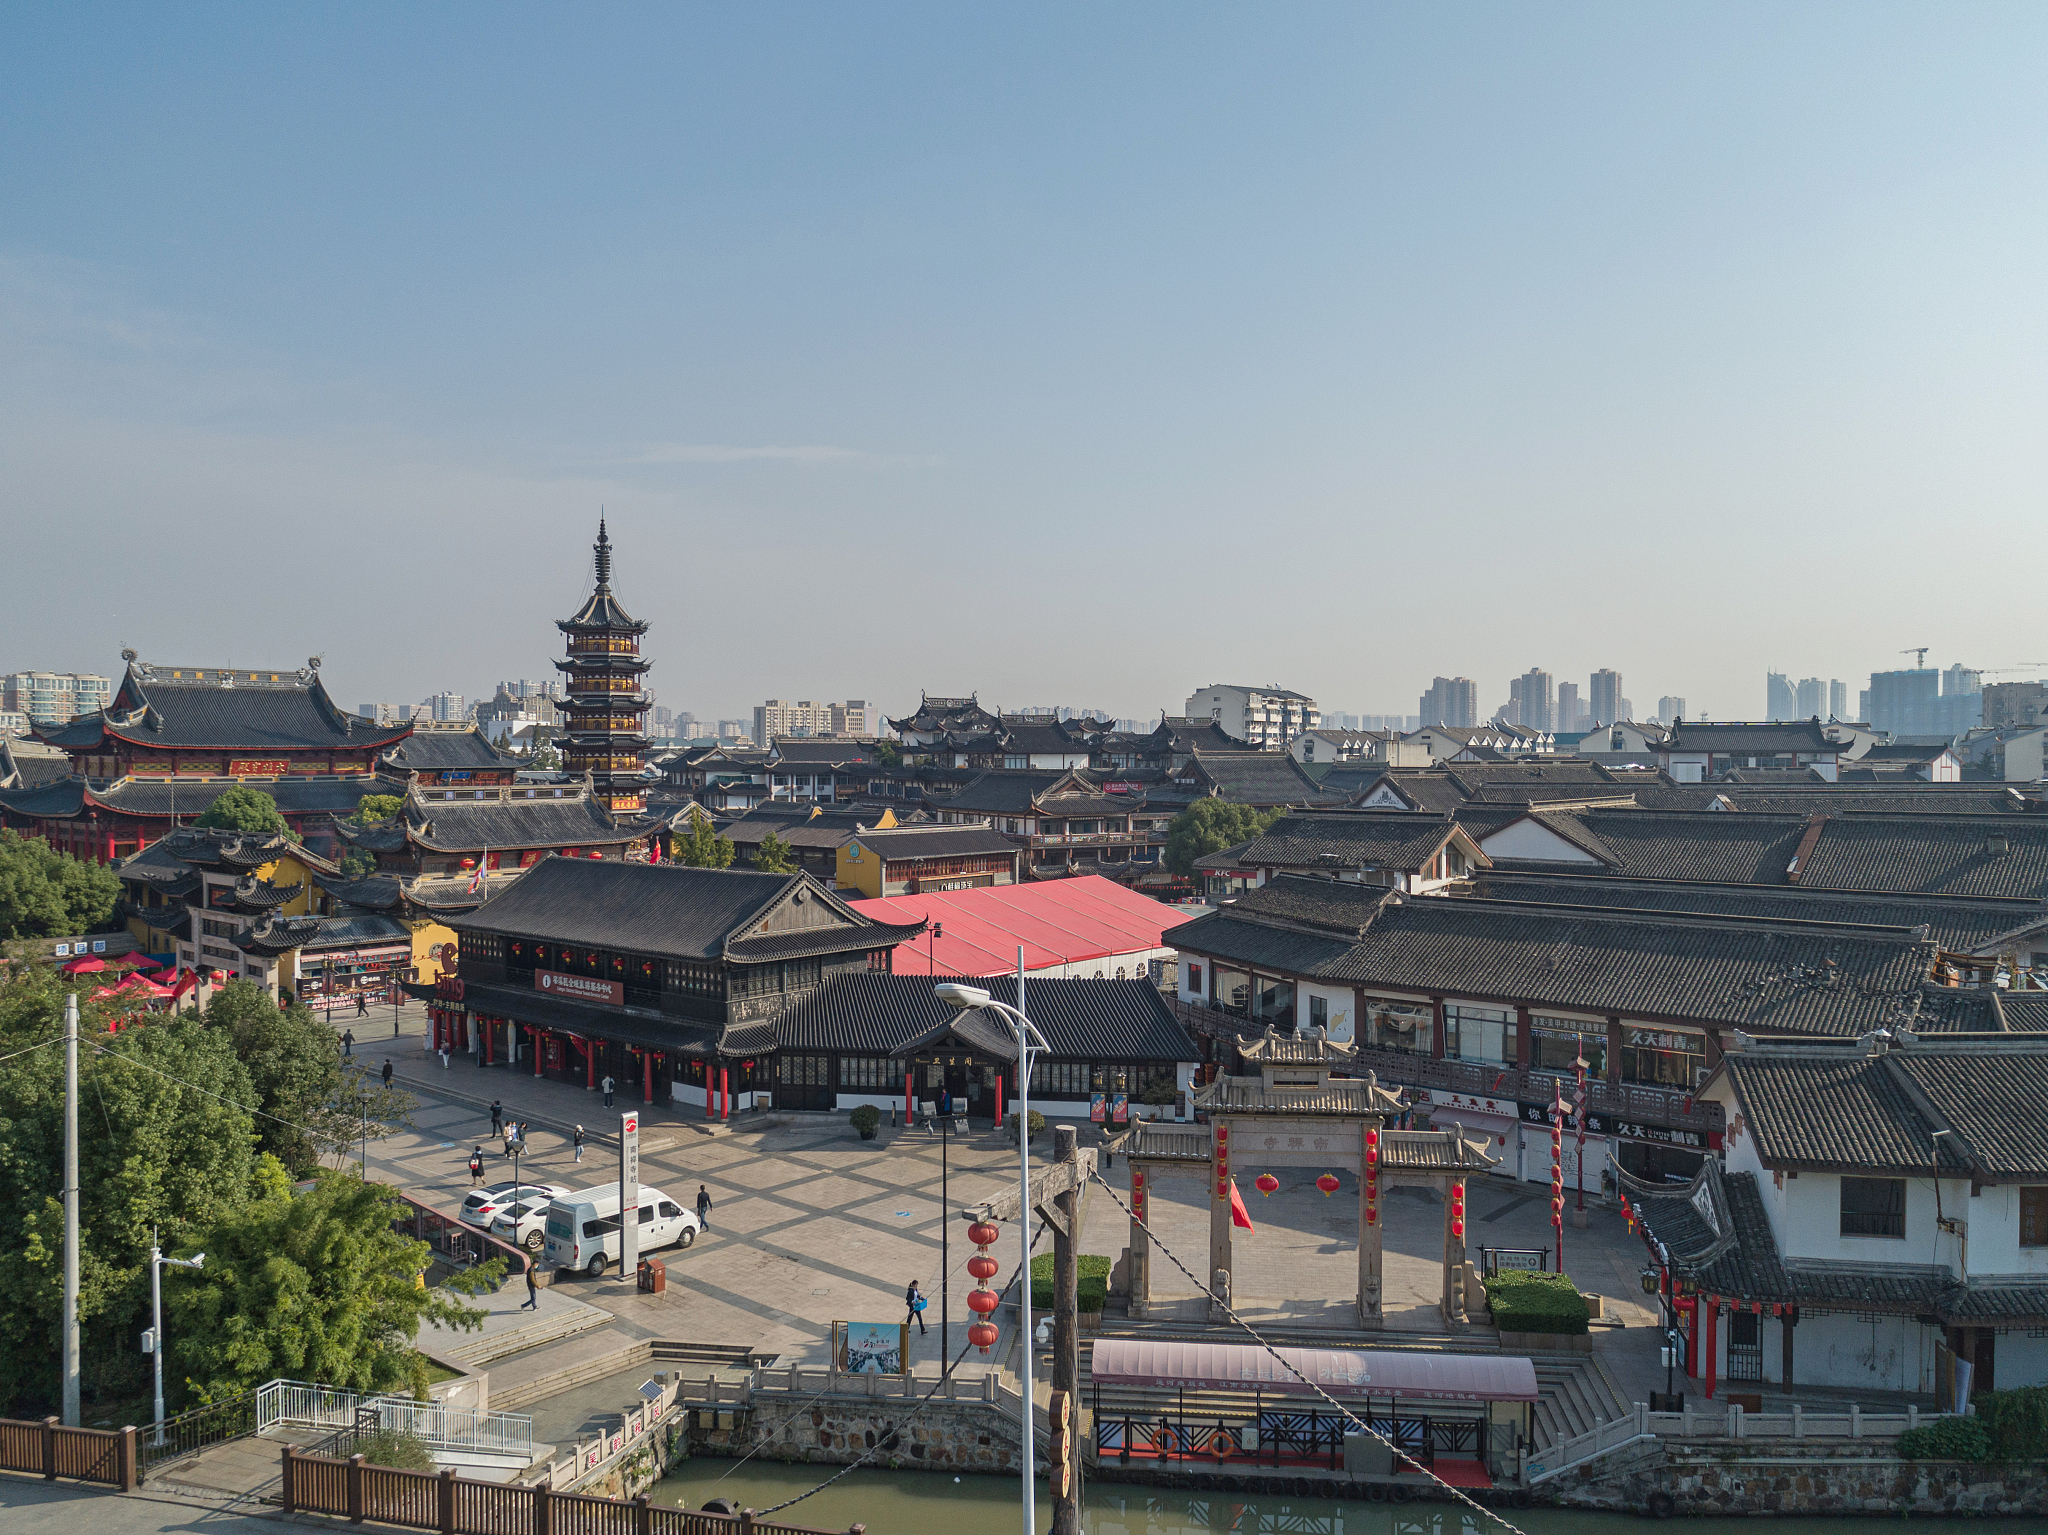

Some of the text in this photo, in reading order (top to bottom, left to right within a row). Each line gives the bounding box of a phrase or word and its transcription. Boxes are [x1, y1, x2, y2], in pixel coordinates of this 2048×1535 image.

[1214, 869, 1231, 877] KFC
[57, 941, 106, 954] 项目部
[1630, 1029, 1688, 1050] 久天刺青
[932, 1056, 973, 1067] 卫生间
[1238, 1365, 1371, 1385] 古运河 水上游
